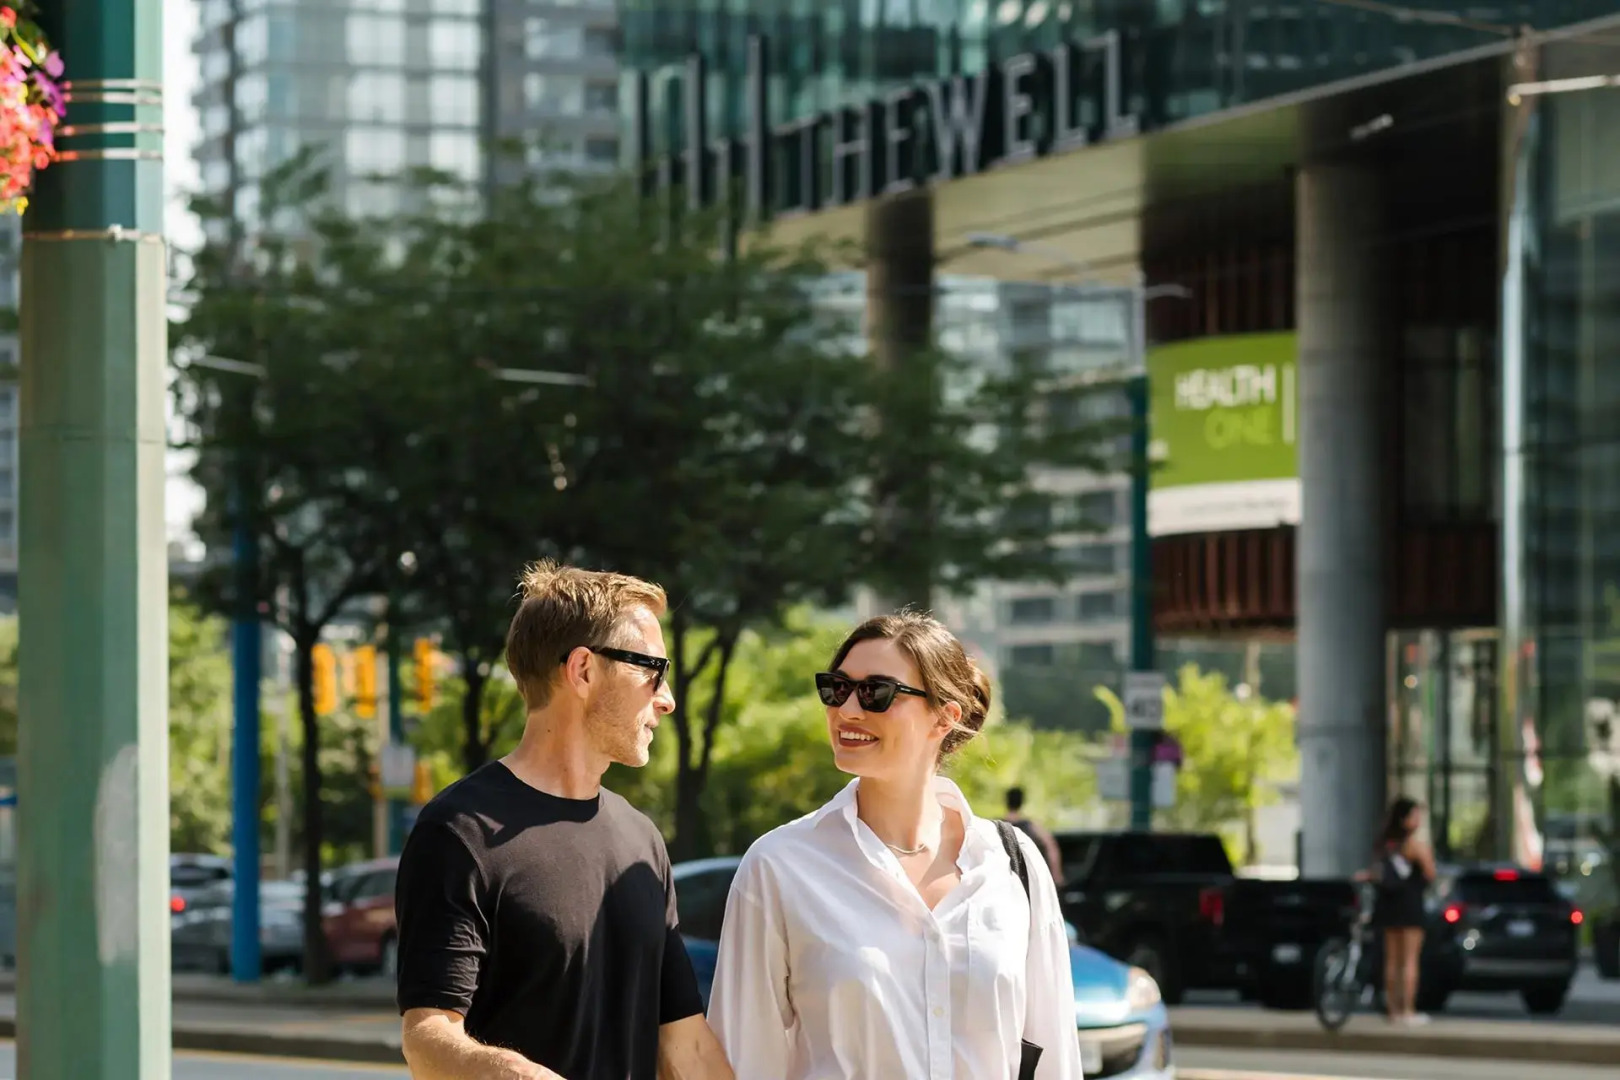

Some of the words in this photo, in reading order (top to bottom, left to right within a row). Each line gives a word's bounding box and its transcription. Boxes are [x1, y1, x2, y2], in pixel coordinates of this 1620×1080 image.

[772, 85, 915, 216] THE
[926, 29, 1138, 181] WELL
[1174, 364, 1275, 411] HEALTH
